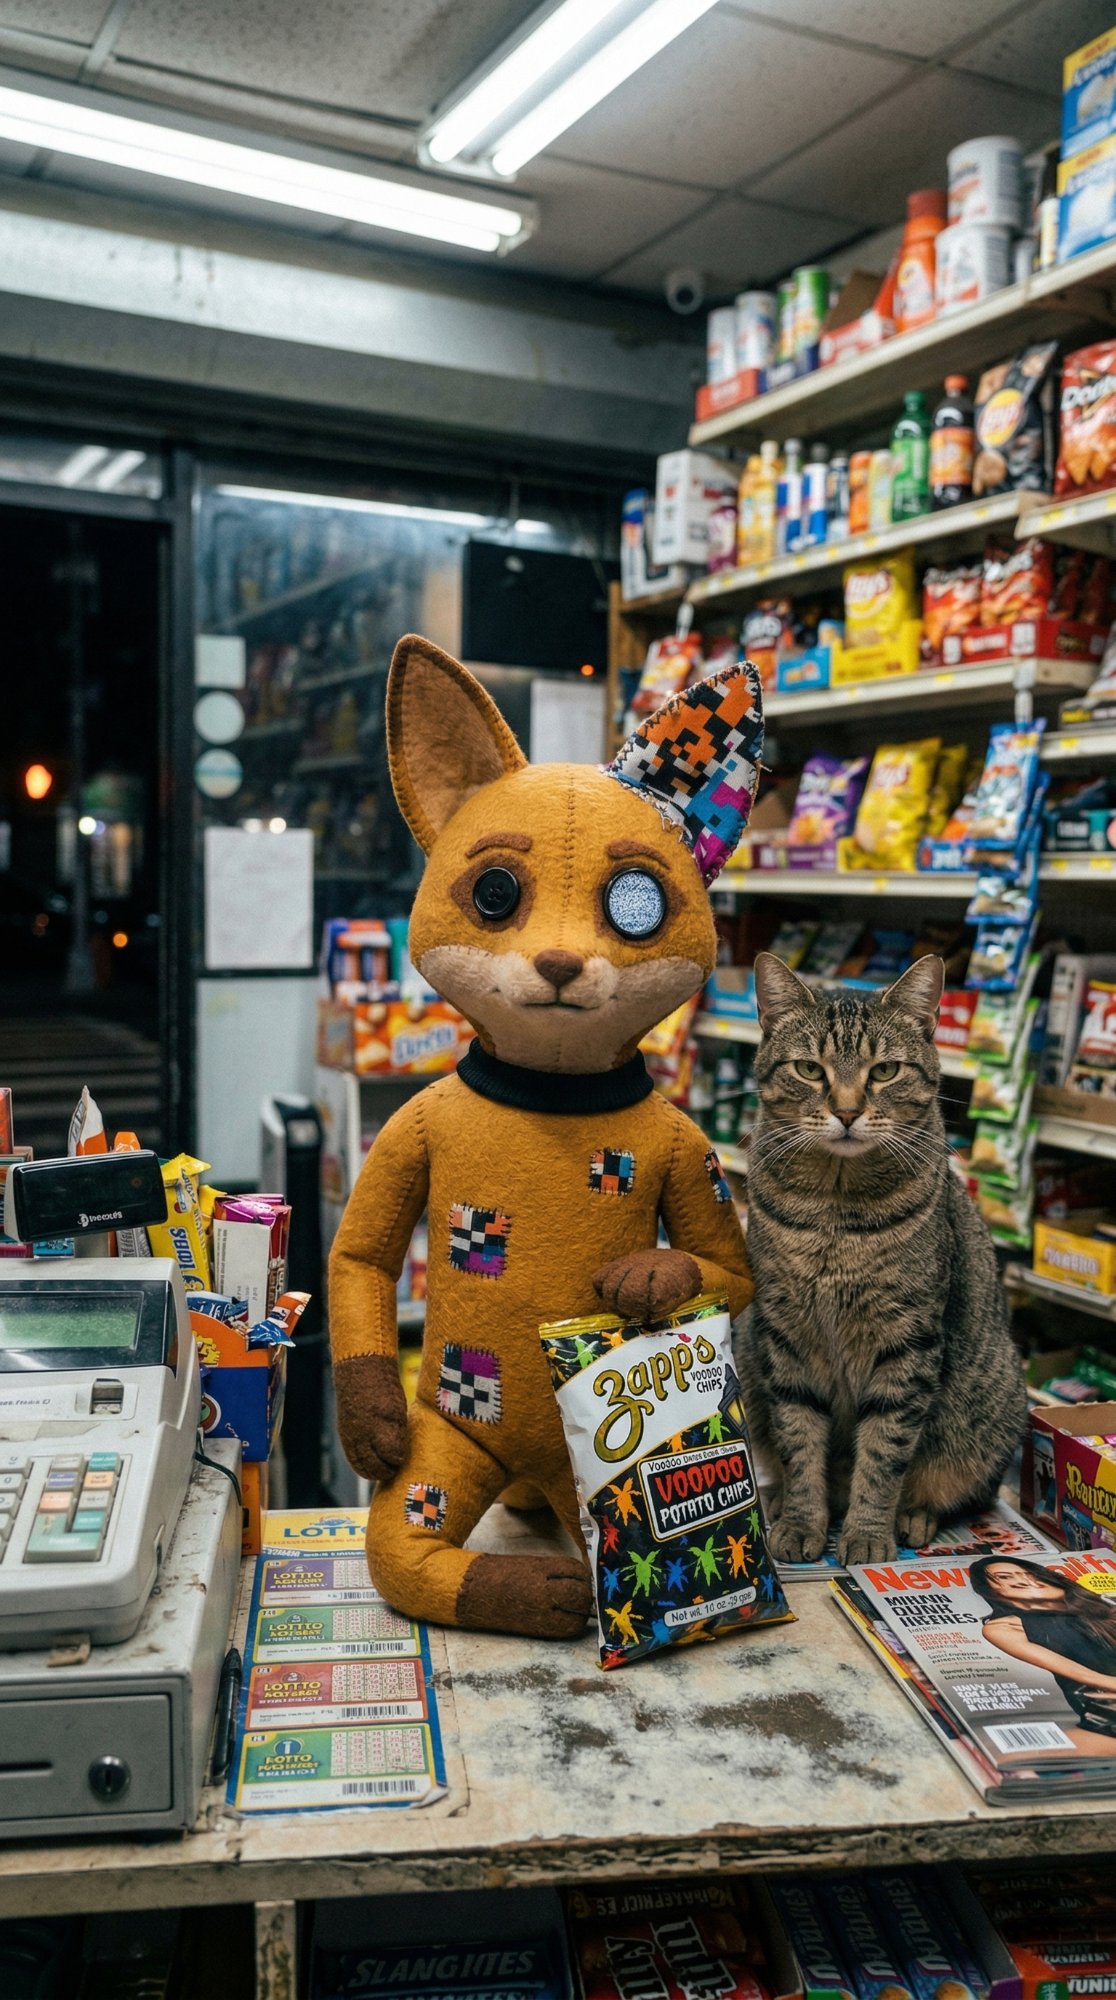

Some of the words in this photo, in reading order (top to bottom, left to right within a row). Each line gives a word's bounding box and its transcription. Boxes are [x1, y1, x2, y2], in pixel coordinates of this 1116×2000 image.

[690, 1366, 723, 1381] VOODOO
[696, 1379, 723, 1393] CHIPS
[655, 1455, 744, 1503] VOODOO
[660, 1492, 714, 1528] POTATO
[718, 1479, 751, 1507] CHIPS
